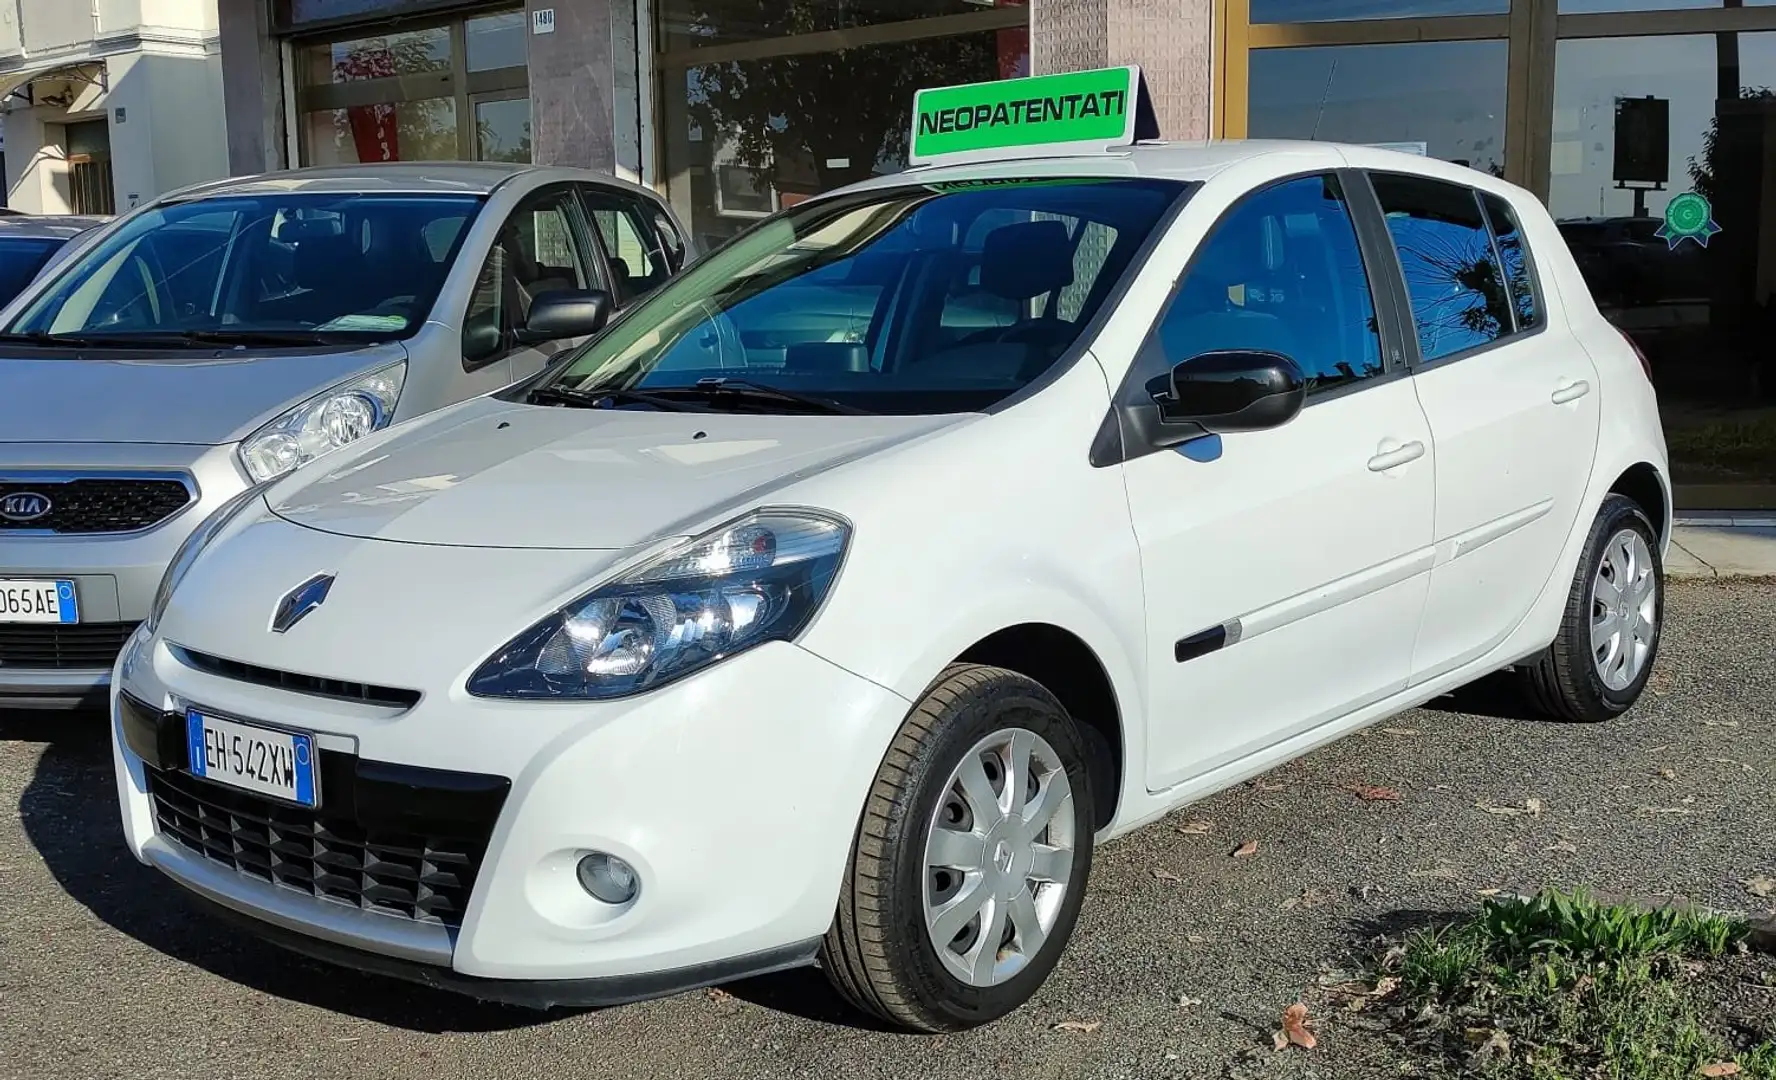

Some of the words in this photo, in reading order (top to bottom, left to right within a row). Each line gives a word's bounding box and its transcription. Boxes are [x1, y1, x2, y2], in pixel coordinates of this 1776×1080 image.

[534, 11, 553, 26] 1480
[919, 90, 1125, 135] NEOPATENTATI
[4, 497, 41, 513] KIA
